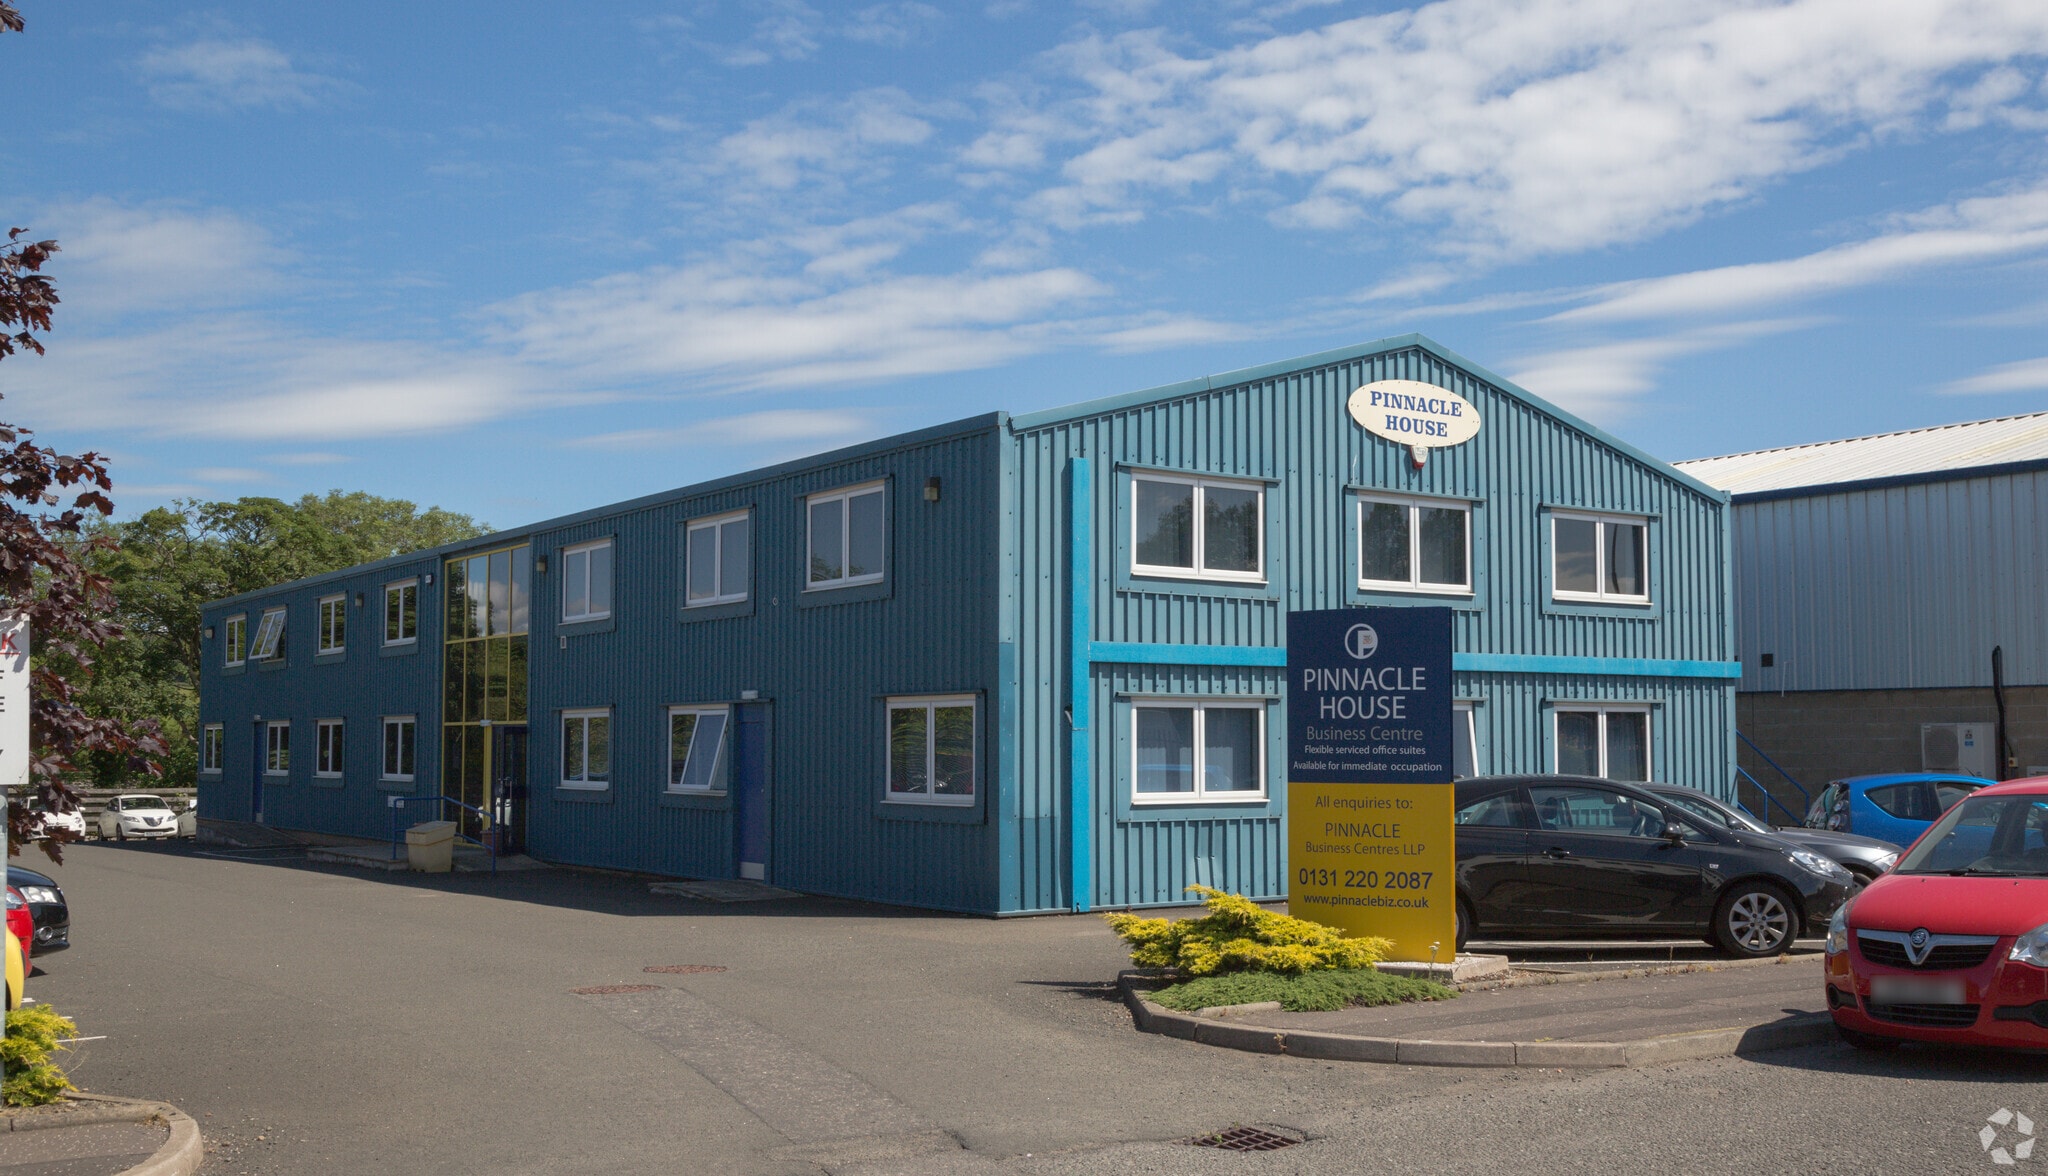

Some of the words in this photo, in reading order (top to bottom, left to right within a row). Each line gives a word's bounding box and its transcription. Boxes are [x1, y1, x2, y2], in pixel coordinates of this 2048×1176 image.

[1370, 391, 1462, 417] PINNACLE
[1385, 415, 1448, 437] HOUSE
[1303, 667, 1426, 691] PINNACLE
[1320, 696, 1406, 719] HOUSE
[1306, 726, 1366, 741] Business
[1370, 726, 1423, 741] Centre
[1304, 745, 1334, 754] Flexible
[1335, 745, 1370, 754] serviced
[1372, 745, 1397, 755] office
[1400, 746, 1426, 755] suites
[1293, 761, 1327, 770] Available
[1328, 761, 1340, 771] for
[1341, 761, 1387, 771] immediate
[1390, 762, 1442, 773] occupation
[1315, 796, 1330, 808] All
[1333, 797, 1392, 811] enquiries
[1395, 798, 1413, 809] to:
[1325, 823, 1401, 839] PINNACLE
[1305, 842, 1351, 854] Business
[1354, 843, 1400, 855] Centres
[1403, 844, 1426, 856] LLP
[1299, 868, 1338, 887] 0131
[1344, 870, 1379, 889] 220
[1384, 871, 1433, 890] 2087
[1303, 894, 1429, 909] www.pinnaclebiz.co.uk
